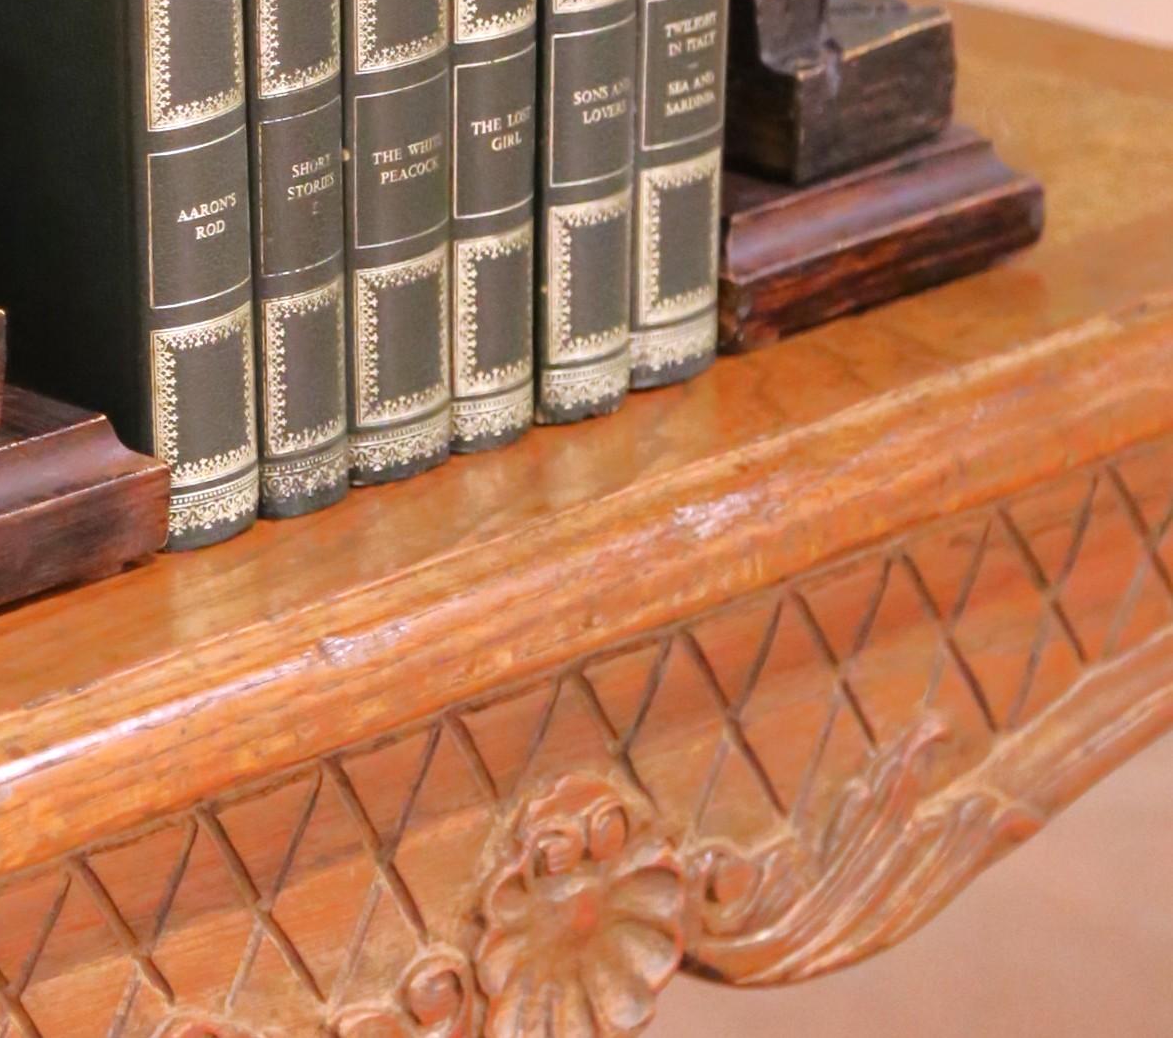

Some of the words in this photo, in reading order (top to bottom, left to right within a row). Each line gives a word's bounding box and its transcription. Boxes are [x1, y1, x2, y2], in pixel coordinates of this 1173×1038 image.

[668, 42, 682, 57] IN
[573, 85, 609, 106] SONS
[470, 117, 502, 136] THE
[491, 131, 522, 152] GIRL
[291, 153, 331, 178] SHORT
[372, 148, 402, 166] THE
[287, 172, 334, 201] STORIES
[177, 192, 237, 222] AARON'S
[195, 219, 226, 240] ROD
